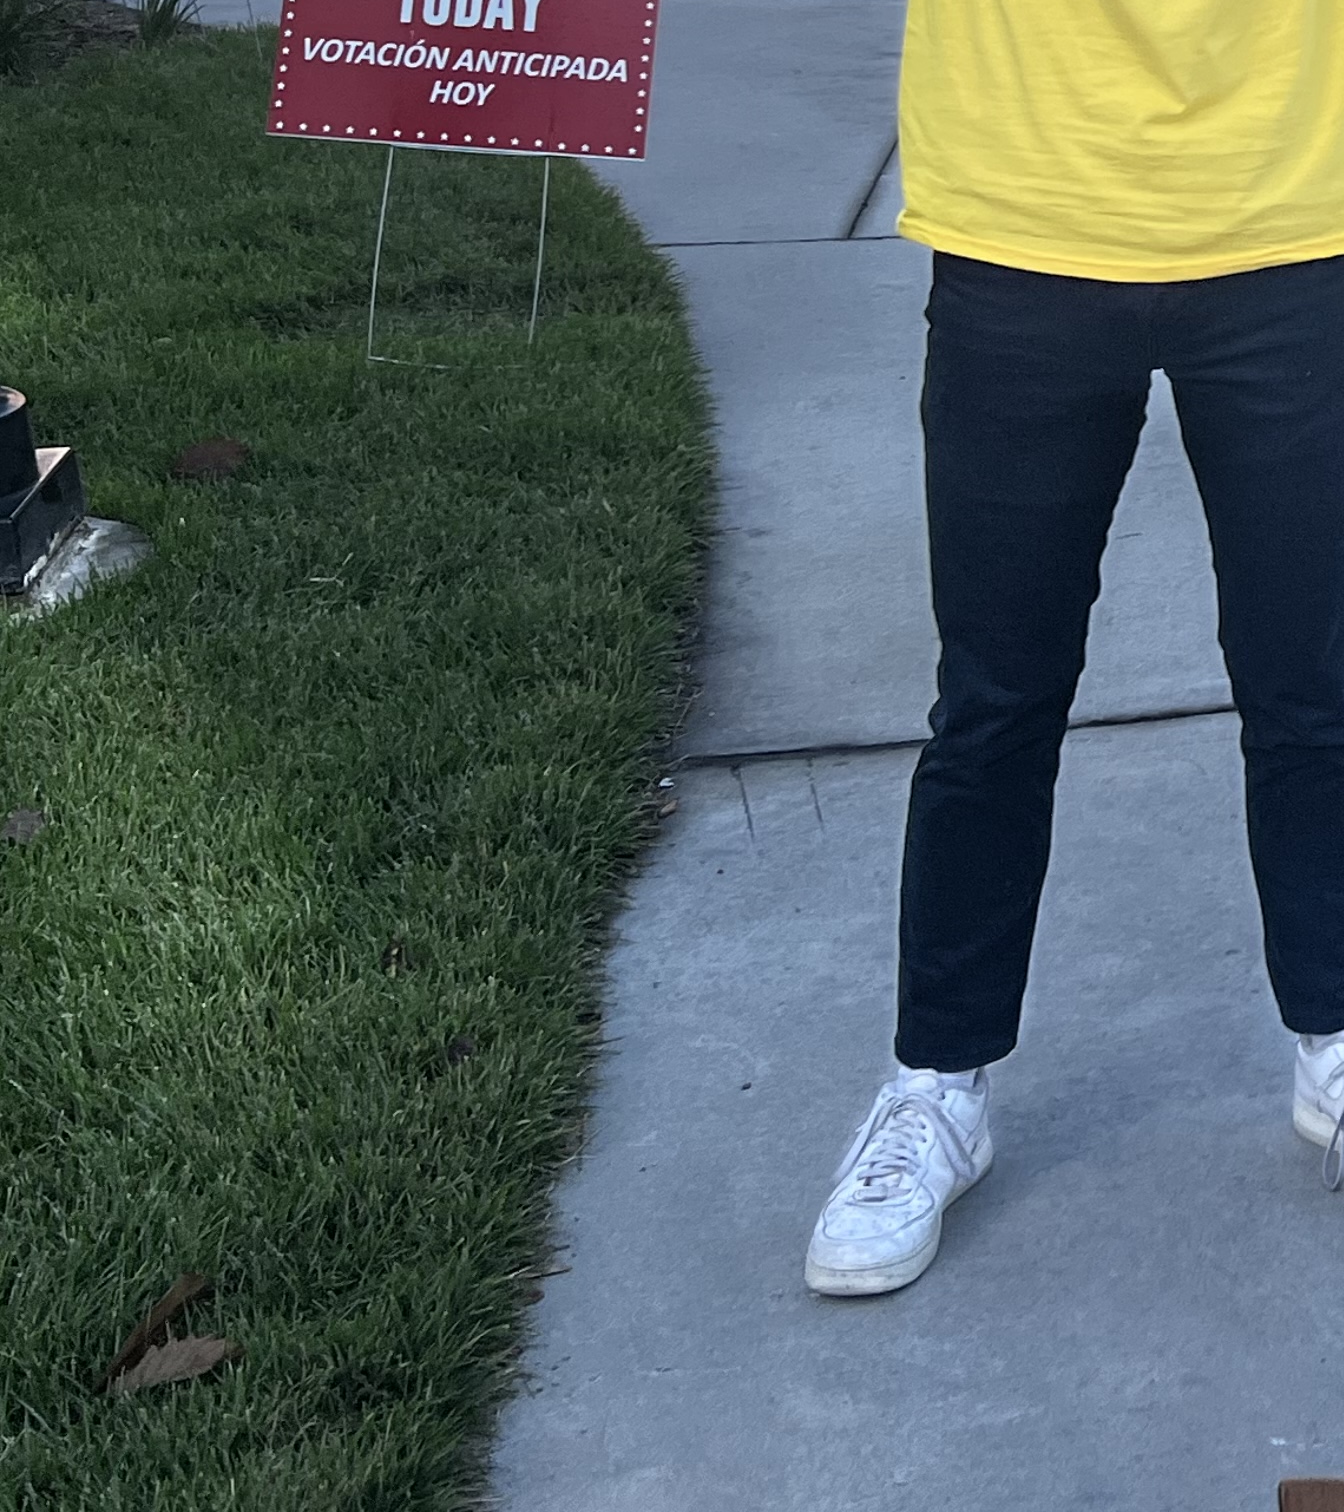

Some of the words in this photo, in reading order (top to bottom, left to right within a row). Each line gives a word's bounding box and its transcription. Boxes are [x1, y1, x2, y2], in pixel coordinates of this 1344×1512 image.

[302, 37, 450, 70] VOTACIÓN
[452, 48, 629, 83] ANTICIPADA
[429, 80, 496, 107] HOY
